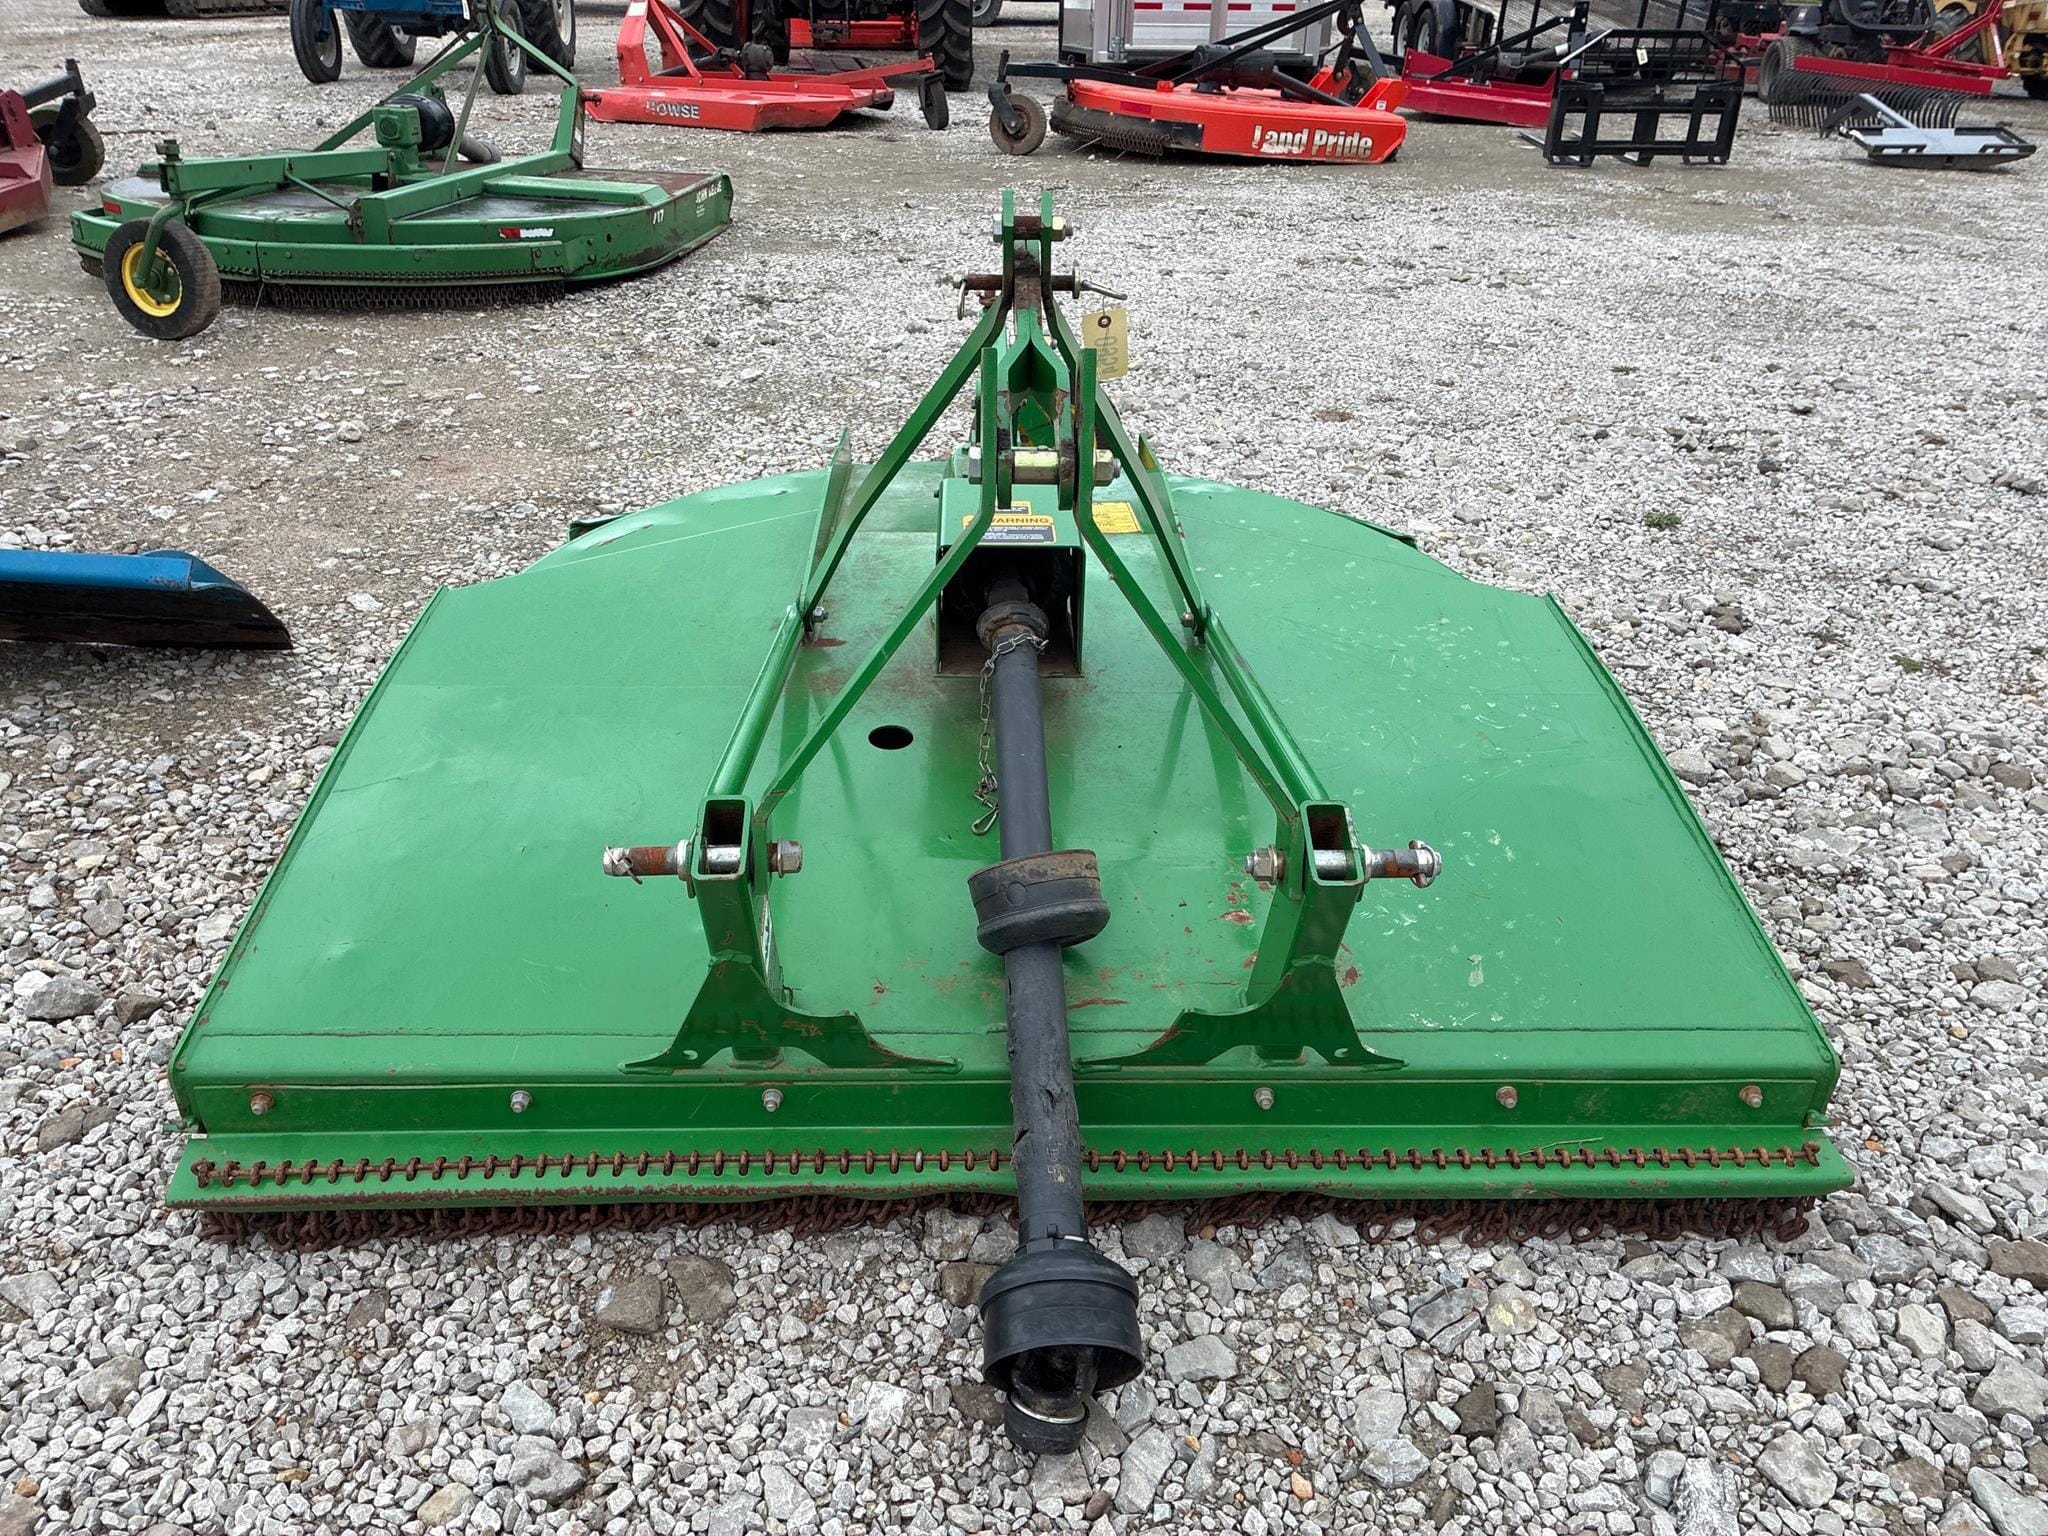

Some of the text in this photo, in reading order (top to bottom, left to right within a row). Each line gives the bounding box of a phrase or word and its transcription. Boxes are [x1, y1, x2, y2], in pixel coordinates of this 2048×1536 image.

[645, 101, 700, 119] HOWSE
[1252, 125, 1373, 159] Land Pride
